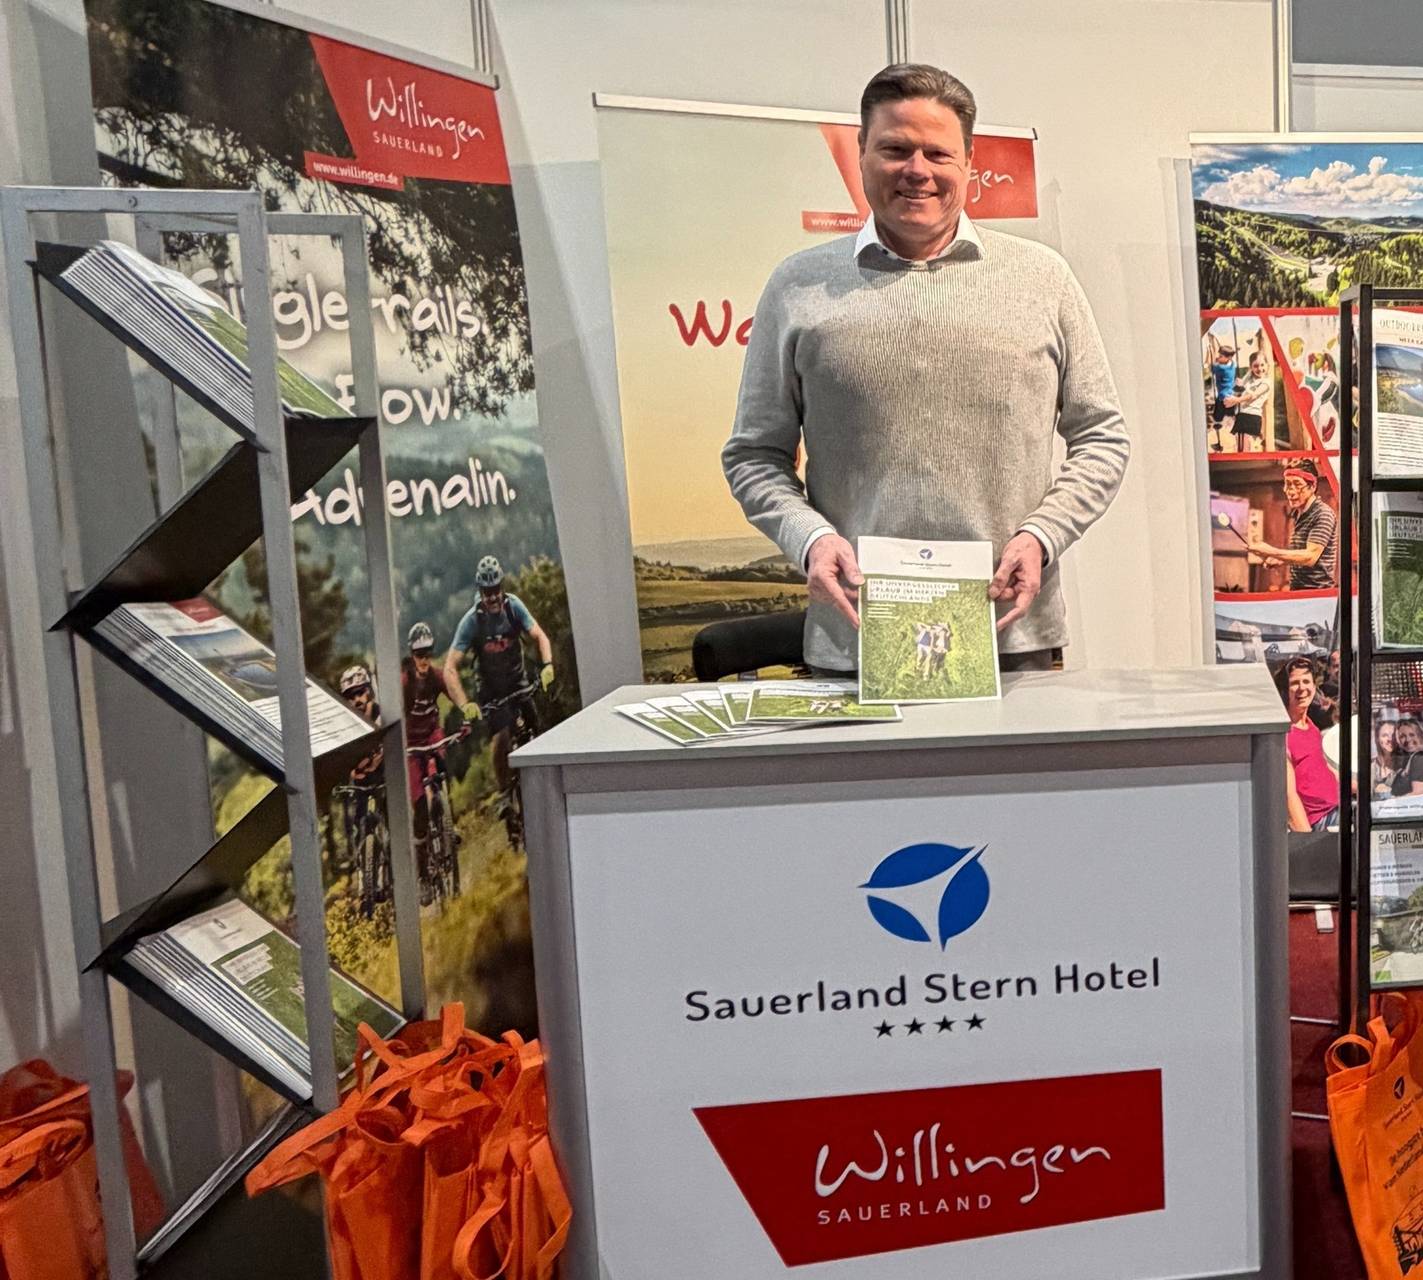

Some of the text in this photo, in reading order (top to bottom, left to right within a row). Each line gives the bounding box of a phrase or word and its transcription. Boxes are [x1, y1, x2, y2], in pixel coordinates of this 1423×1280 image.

[366, 77, 485, 160] Willingen
[372, 131, 444, 158] SAUERLAND
[313, 161, 399, 186] www.willingen.de
[811, 218, 867, 229] www.willin
[334, 374, 462, 427] Fow.
[289, 456, 517, 527] Adenalin.
[685, 957, 1160, 1022] Sauerland Stern Hotel
[815, 1122, 1111, 1204] Willingen
[818, 1194, 991, 1225] SAUERLAND
